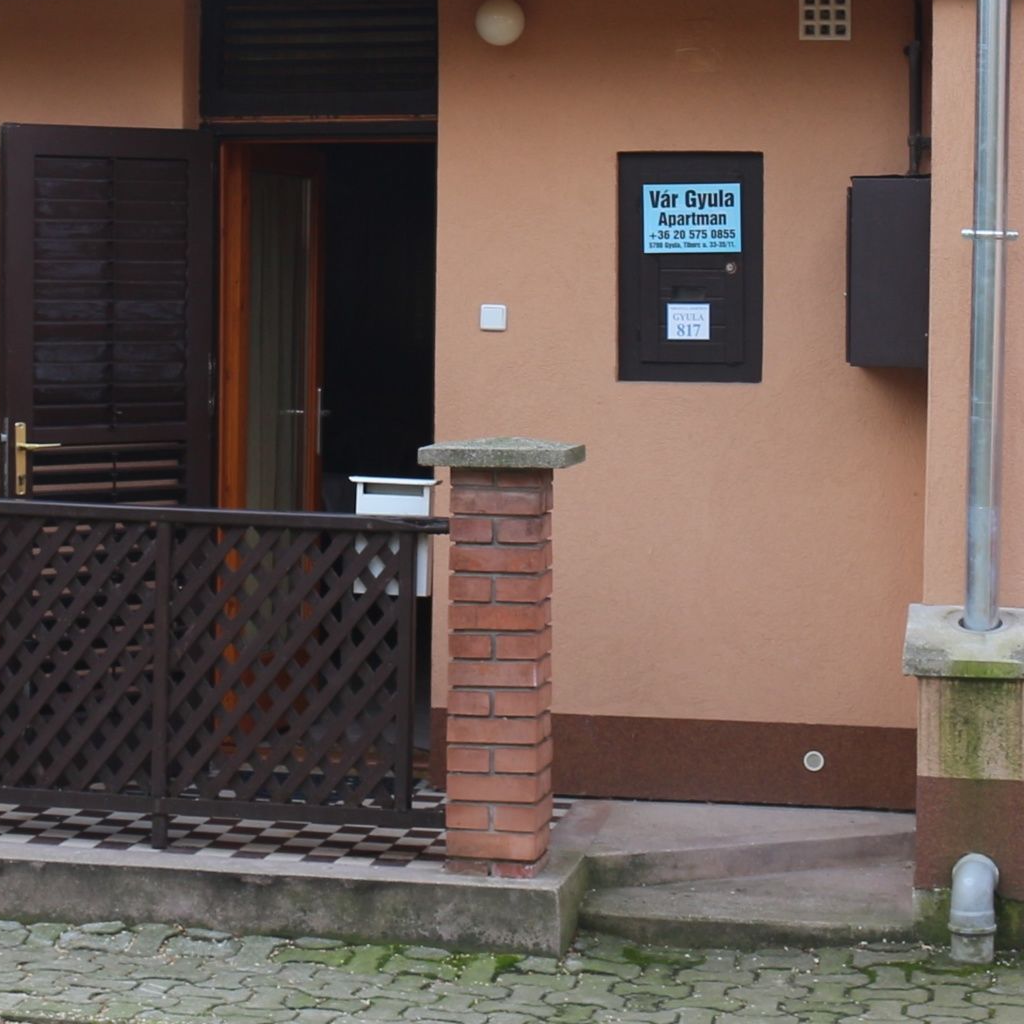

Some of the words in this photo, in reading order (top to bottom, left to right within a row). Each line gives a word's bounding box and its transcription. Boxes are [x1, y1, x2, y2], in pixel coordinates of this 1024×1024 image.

[649, 189, 678, 207] Vár
[685, 189, 734, 209] Gyula
[659, 212, 726, 228] Apartman
[649, 231, 670, 240] +36
[673, 230, 686, 240] 20
[689, 230, 707, 239] 575
[710, 229, 735, 239] 0855
[673, 313, 704, 321] GYULA
[677, 324, 701, 336] 817
